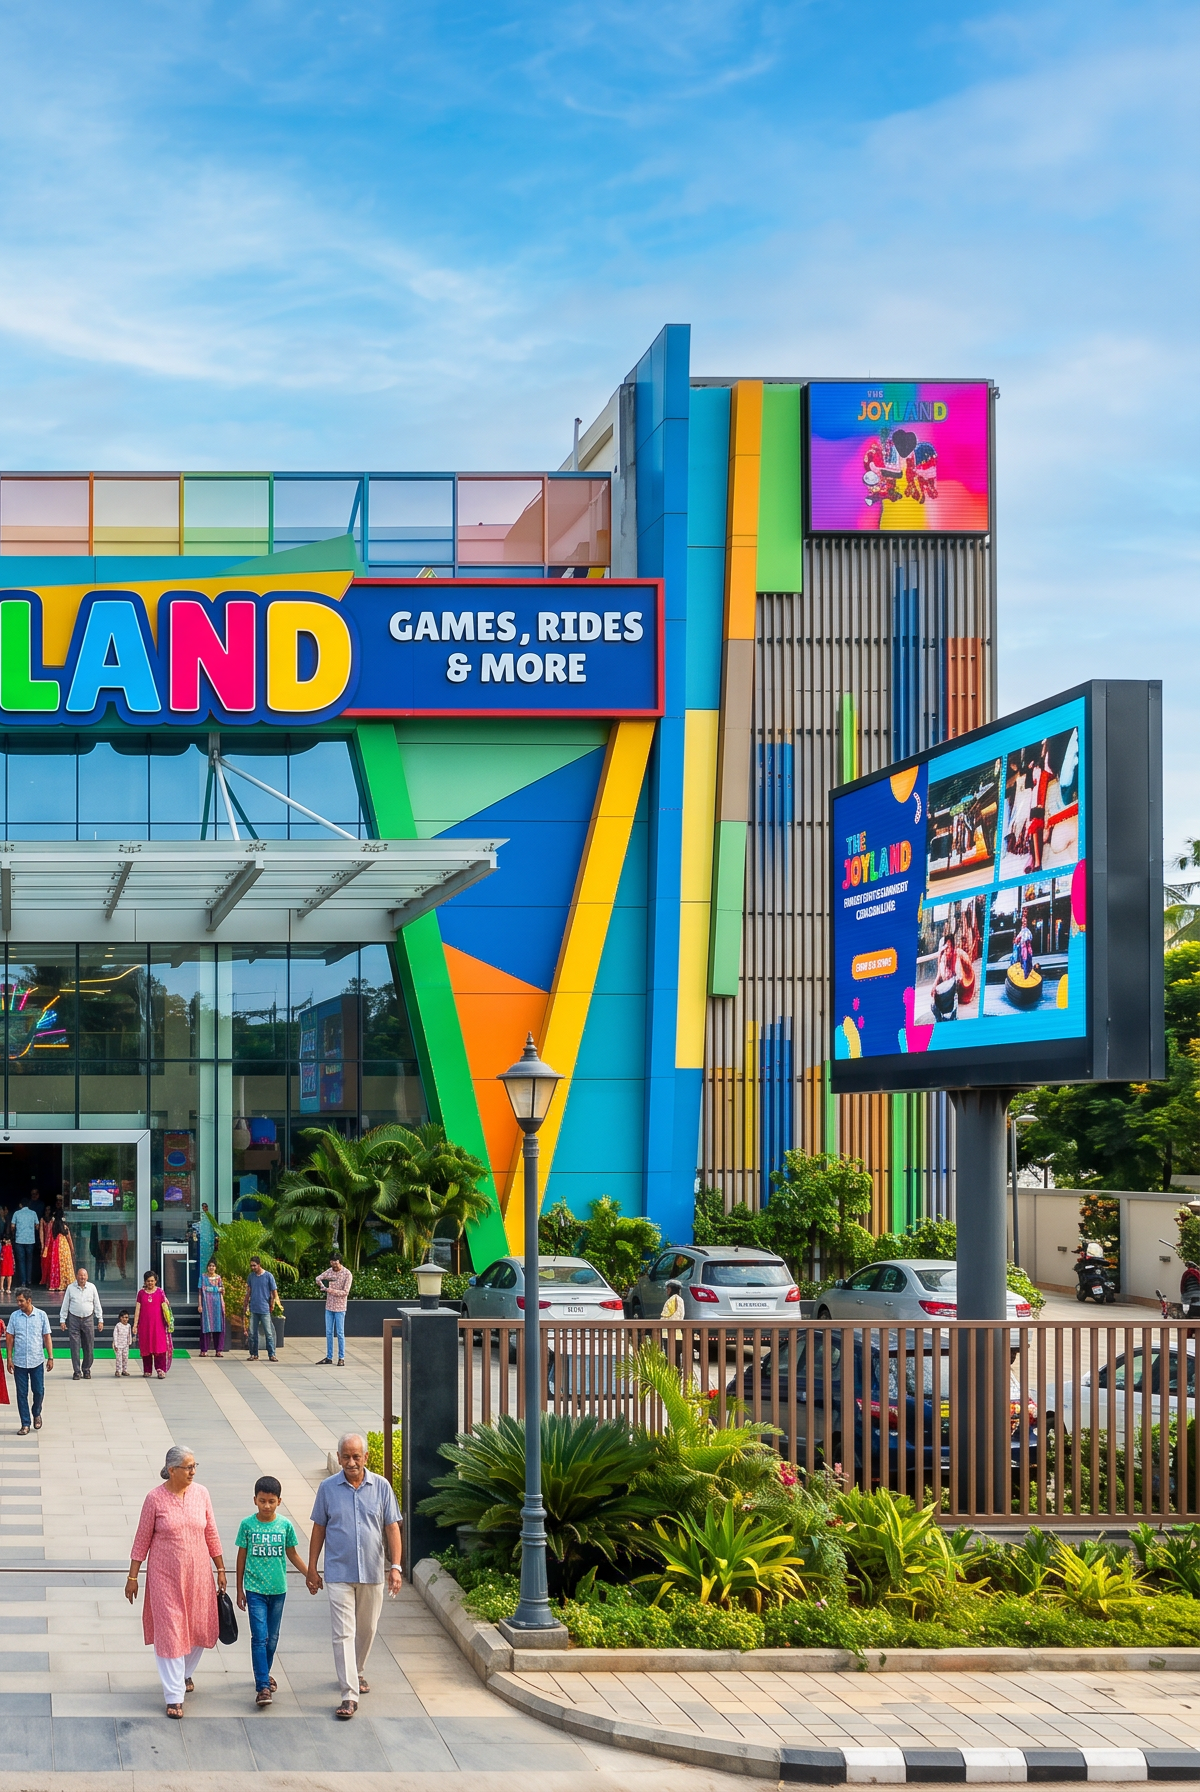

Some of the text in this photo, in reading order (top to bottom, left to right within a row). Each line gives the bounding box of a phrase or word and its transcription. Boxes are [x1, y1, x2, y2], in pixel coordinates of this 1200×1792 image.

[858, 401, 948, 422] JOYLAND
[388, 611, 644, 646] GAMES, RIDES
[446, 653, 588, 684] & MORE
[846, 831, 867, 856] THE
[842, 840, 912, 890] JOYLAND
